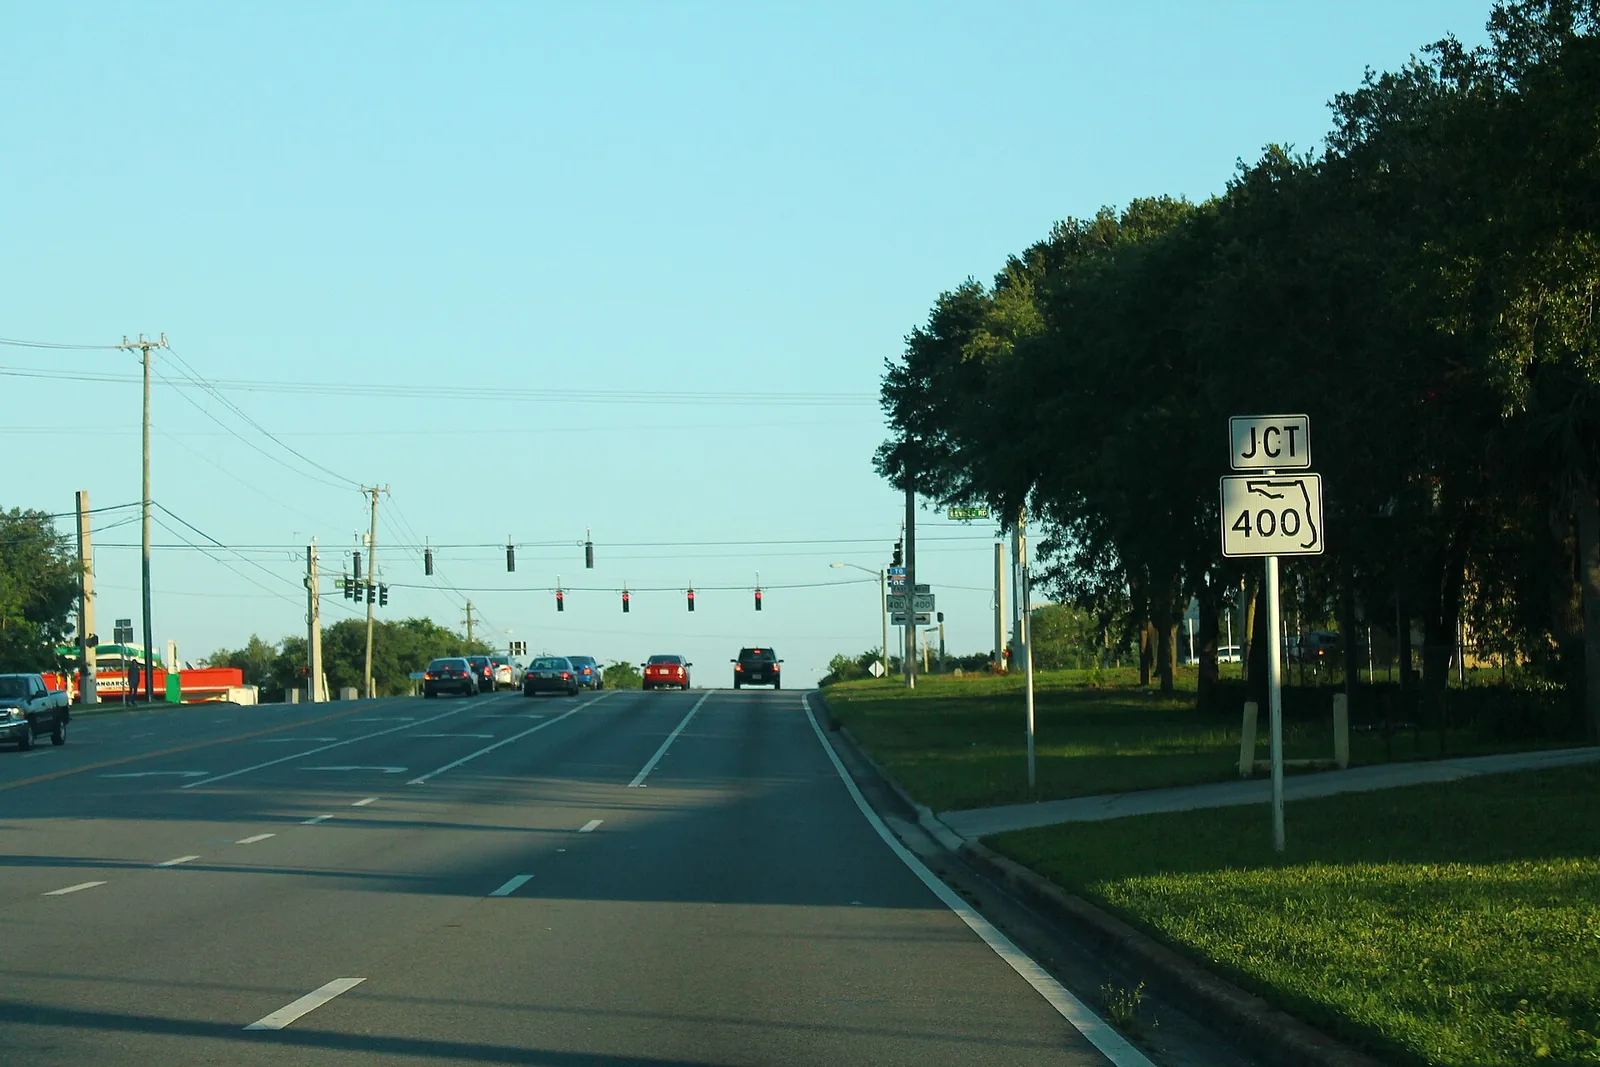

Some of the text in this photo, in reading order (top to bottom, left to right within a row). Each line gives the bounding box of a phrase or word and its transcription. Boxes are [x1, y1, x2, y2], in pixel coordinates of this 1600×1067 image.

[1241, 426, 1300, 459] JCT
[1231, 508, 1300, 538] 400
[888, 601, 904, 609] 400
[914, 601, 930, 609] 400
